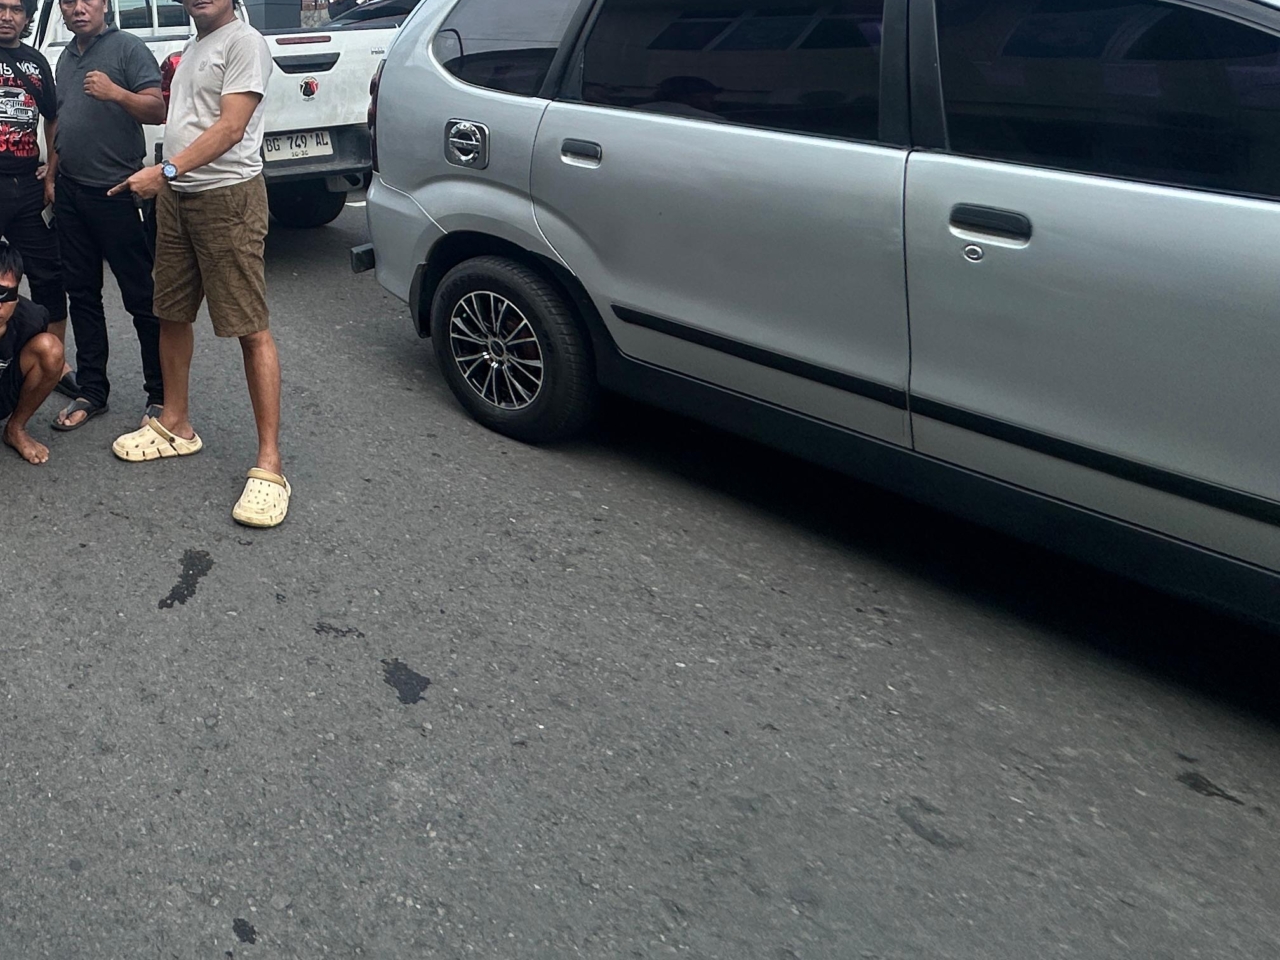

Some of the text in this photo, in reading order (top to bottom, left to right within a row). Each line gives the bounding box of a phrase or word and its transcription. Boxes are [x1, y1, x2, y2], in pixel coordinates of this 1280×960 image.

[265, 132, 328, 152] BG 749 AL
